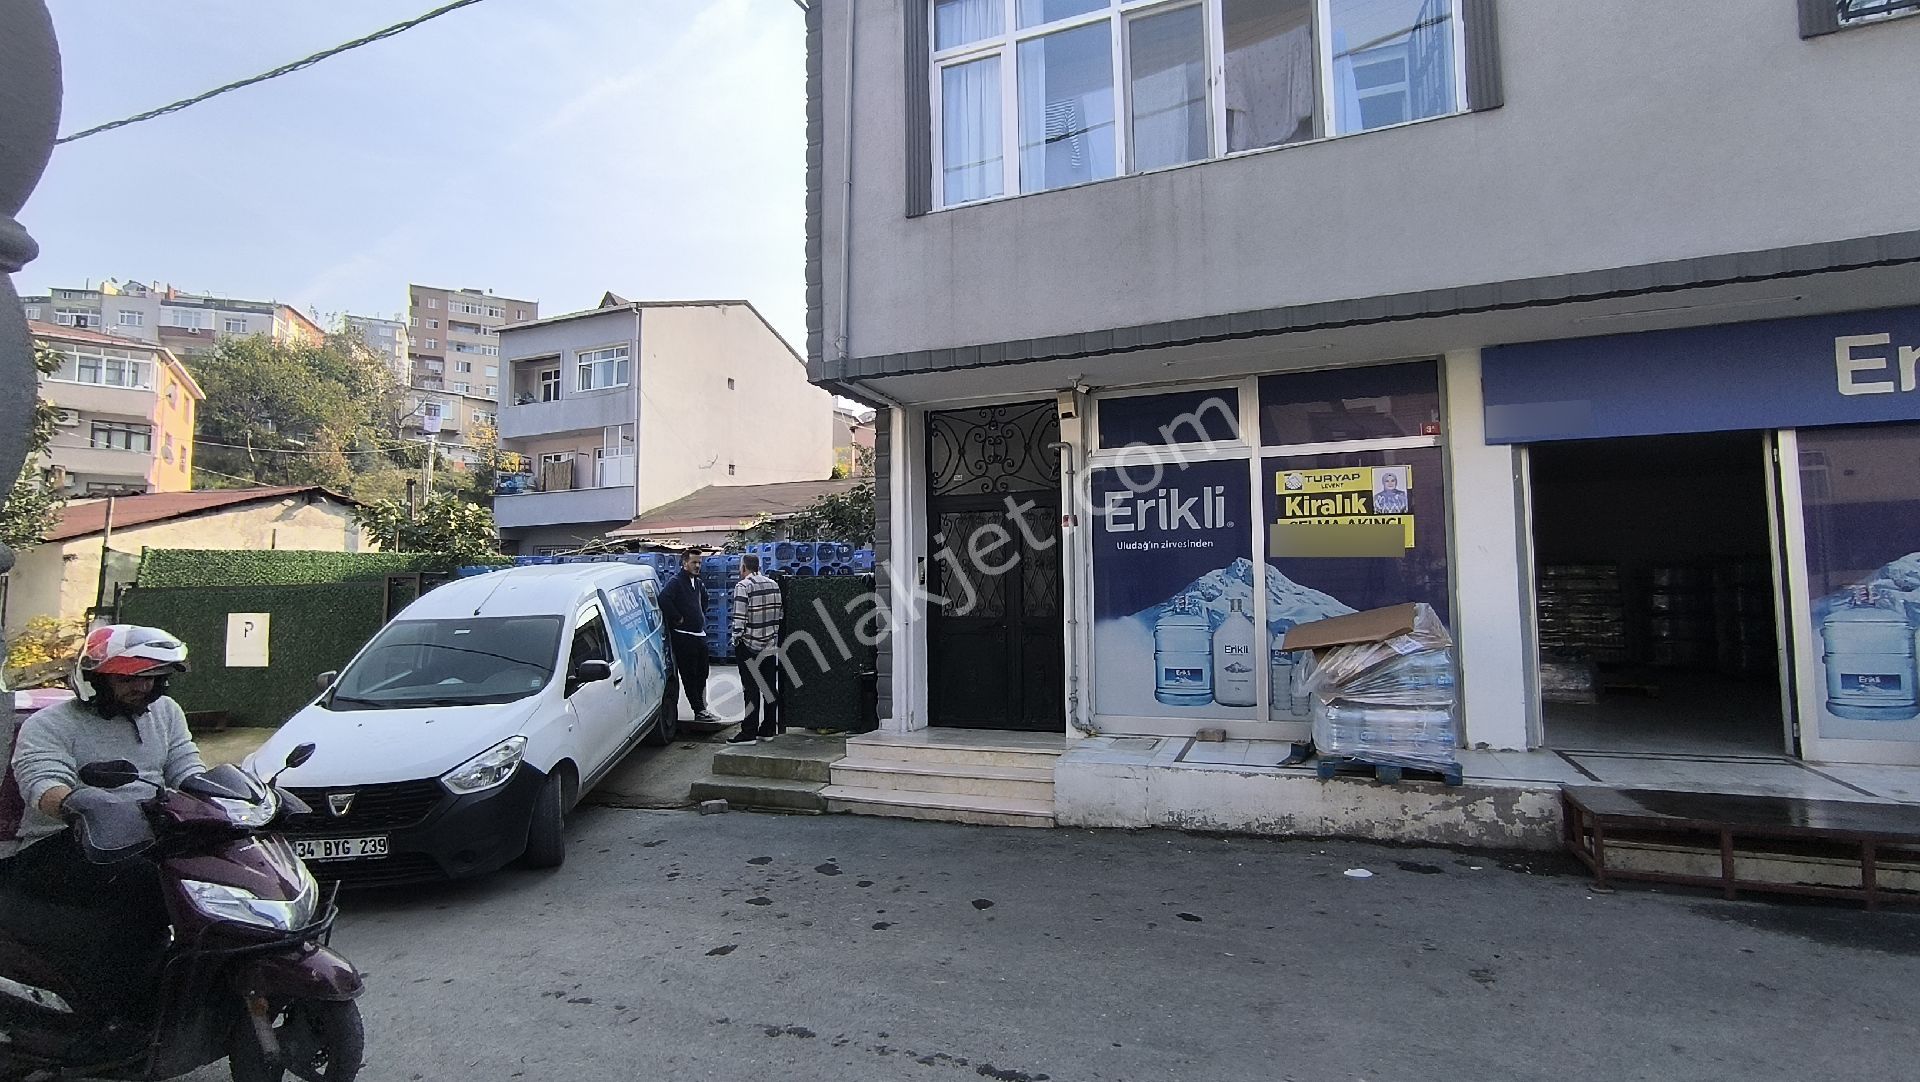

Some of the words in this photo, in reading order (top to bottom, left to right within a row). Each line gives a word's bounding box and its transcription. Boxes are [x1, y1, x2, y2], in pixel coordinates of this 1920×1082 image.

[1304, 473, 1361, 483] TURYAP
[1285, 493, 1367, 516] Kiralık
[244, 621, 254, 638] P
[297, 842, 314, 858] 34
[323, 840, 351, 857] BYG
[359, 838, 387, 855] 239
